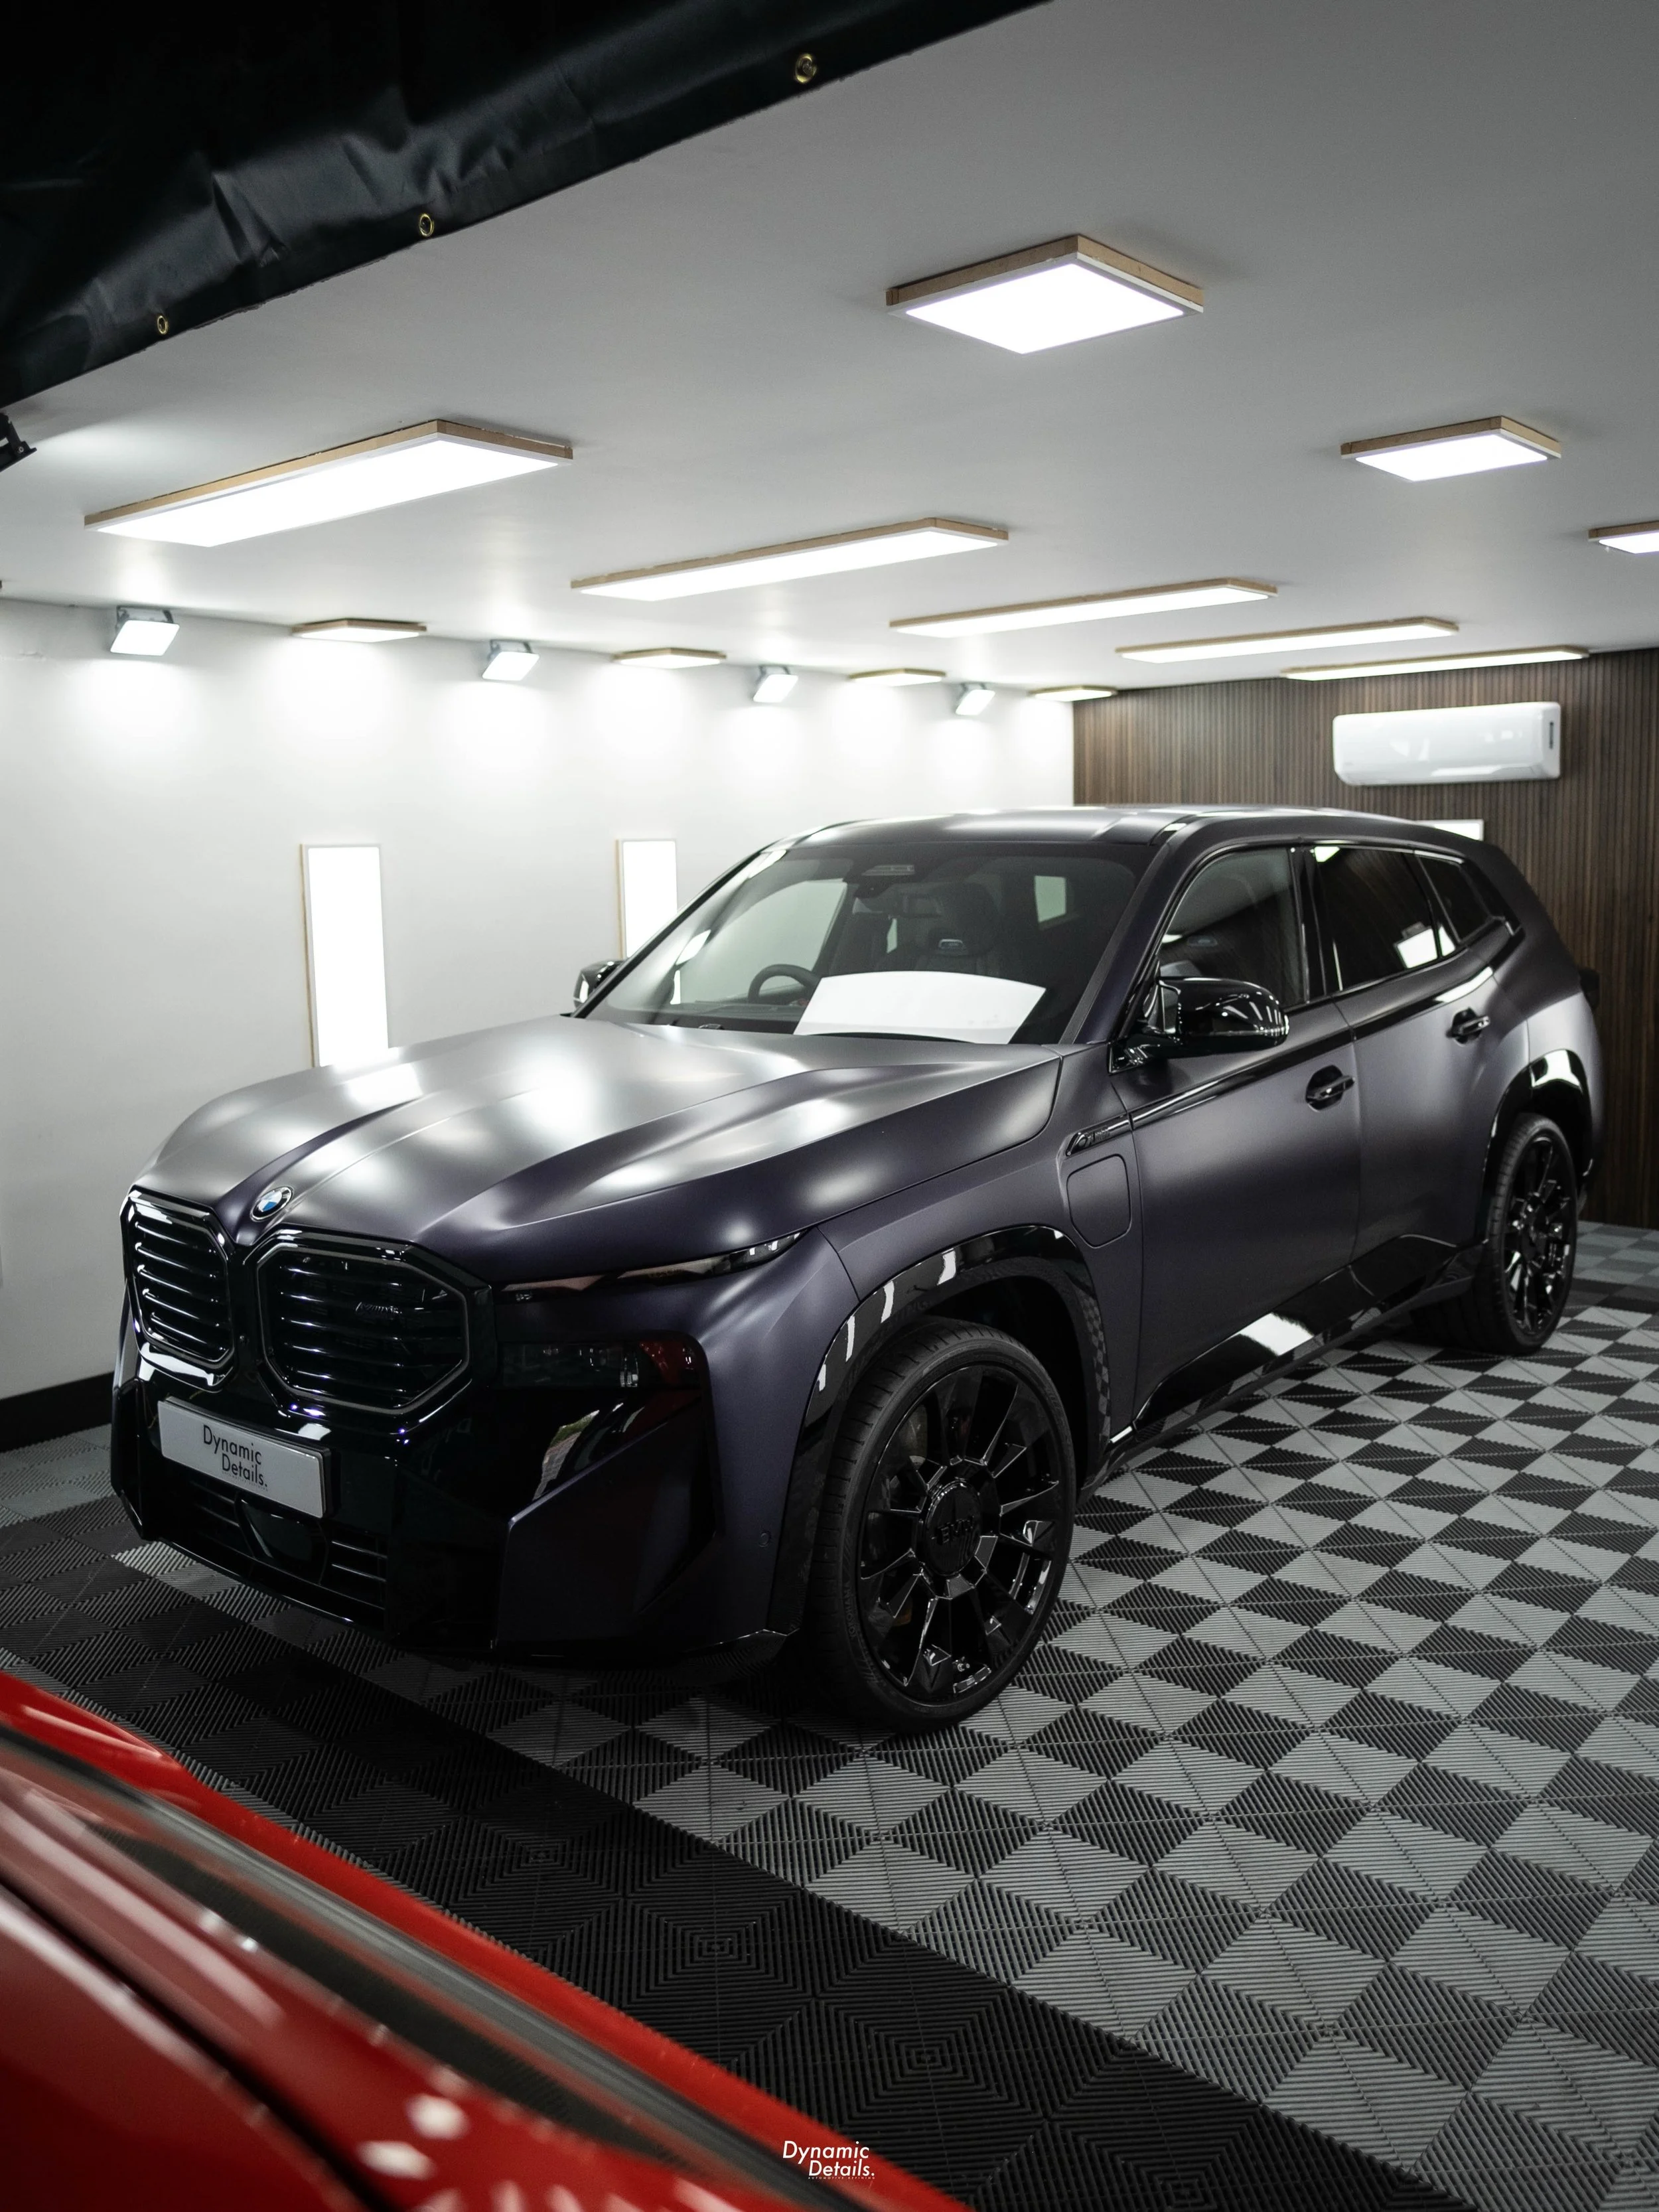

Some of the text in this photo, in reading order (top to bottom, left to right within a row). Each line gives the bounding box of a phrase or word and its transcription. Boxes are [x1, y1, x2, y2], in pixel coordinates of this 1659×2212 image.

[203, 1424, 262, 1465] Dynamic
[222, 1453, 267, 1487] Details.
[843, 1582, 856, 1641] YOKOHAMA
